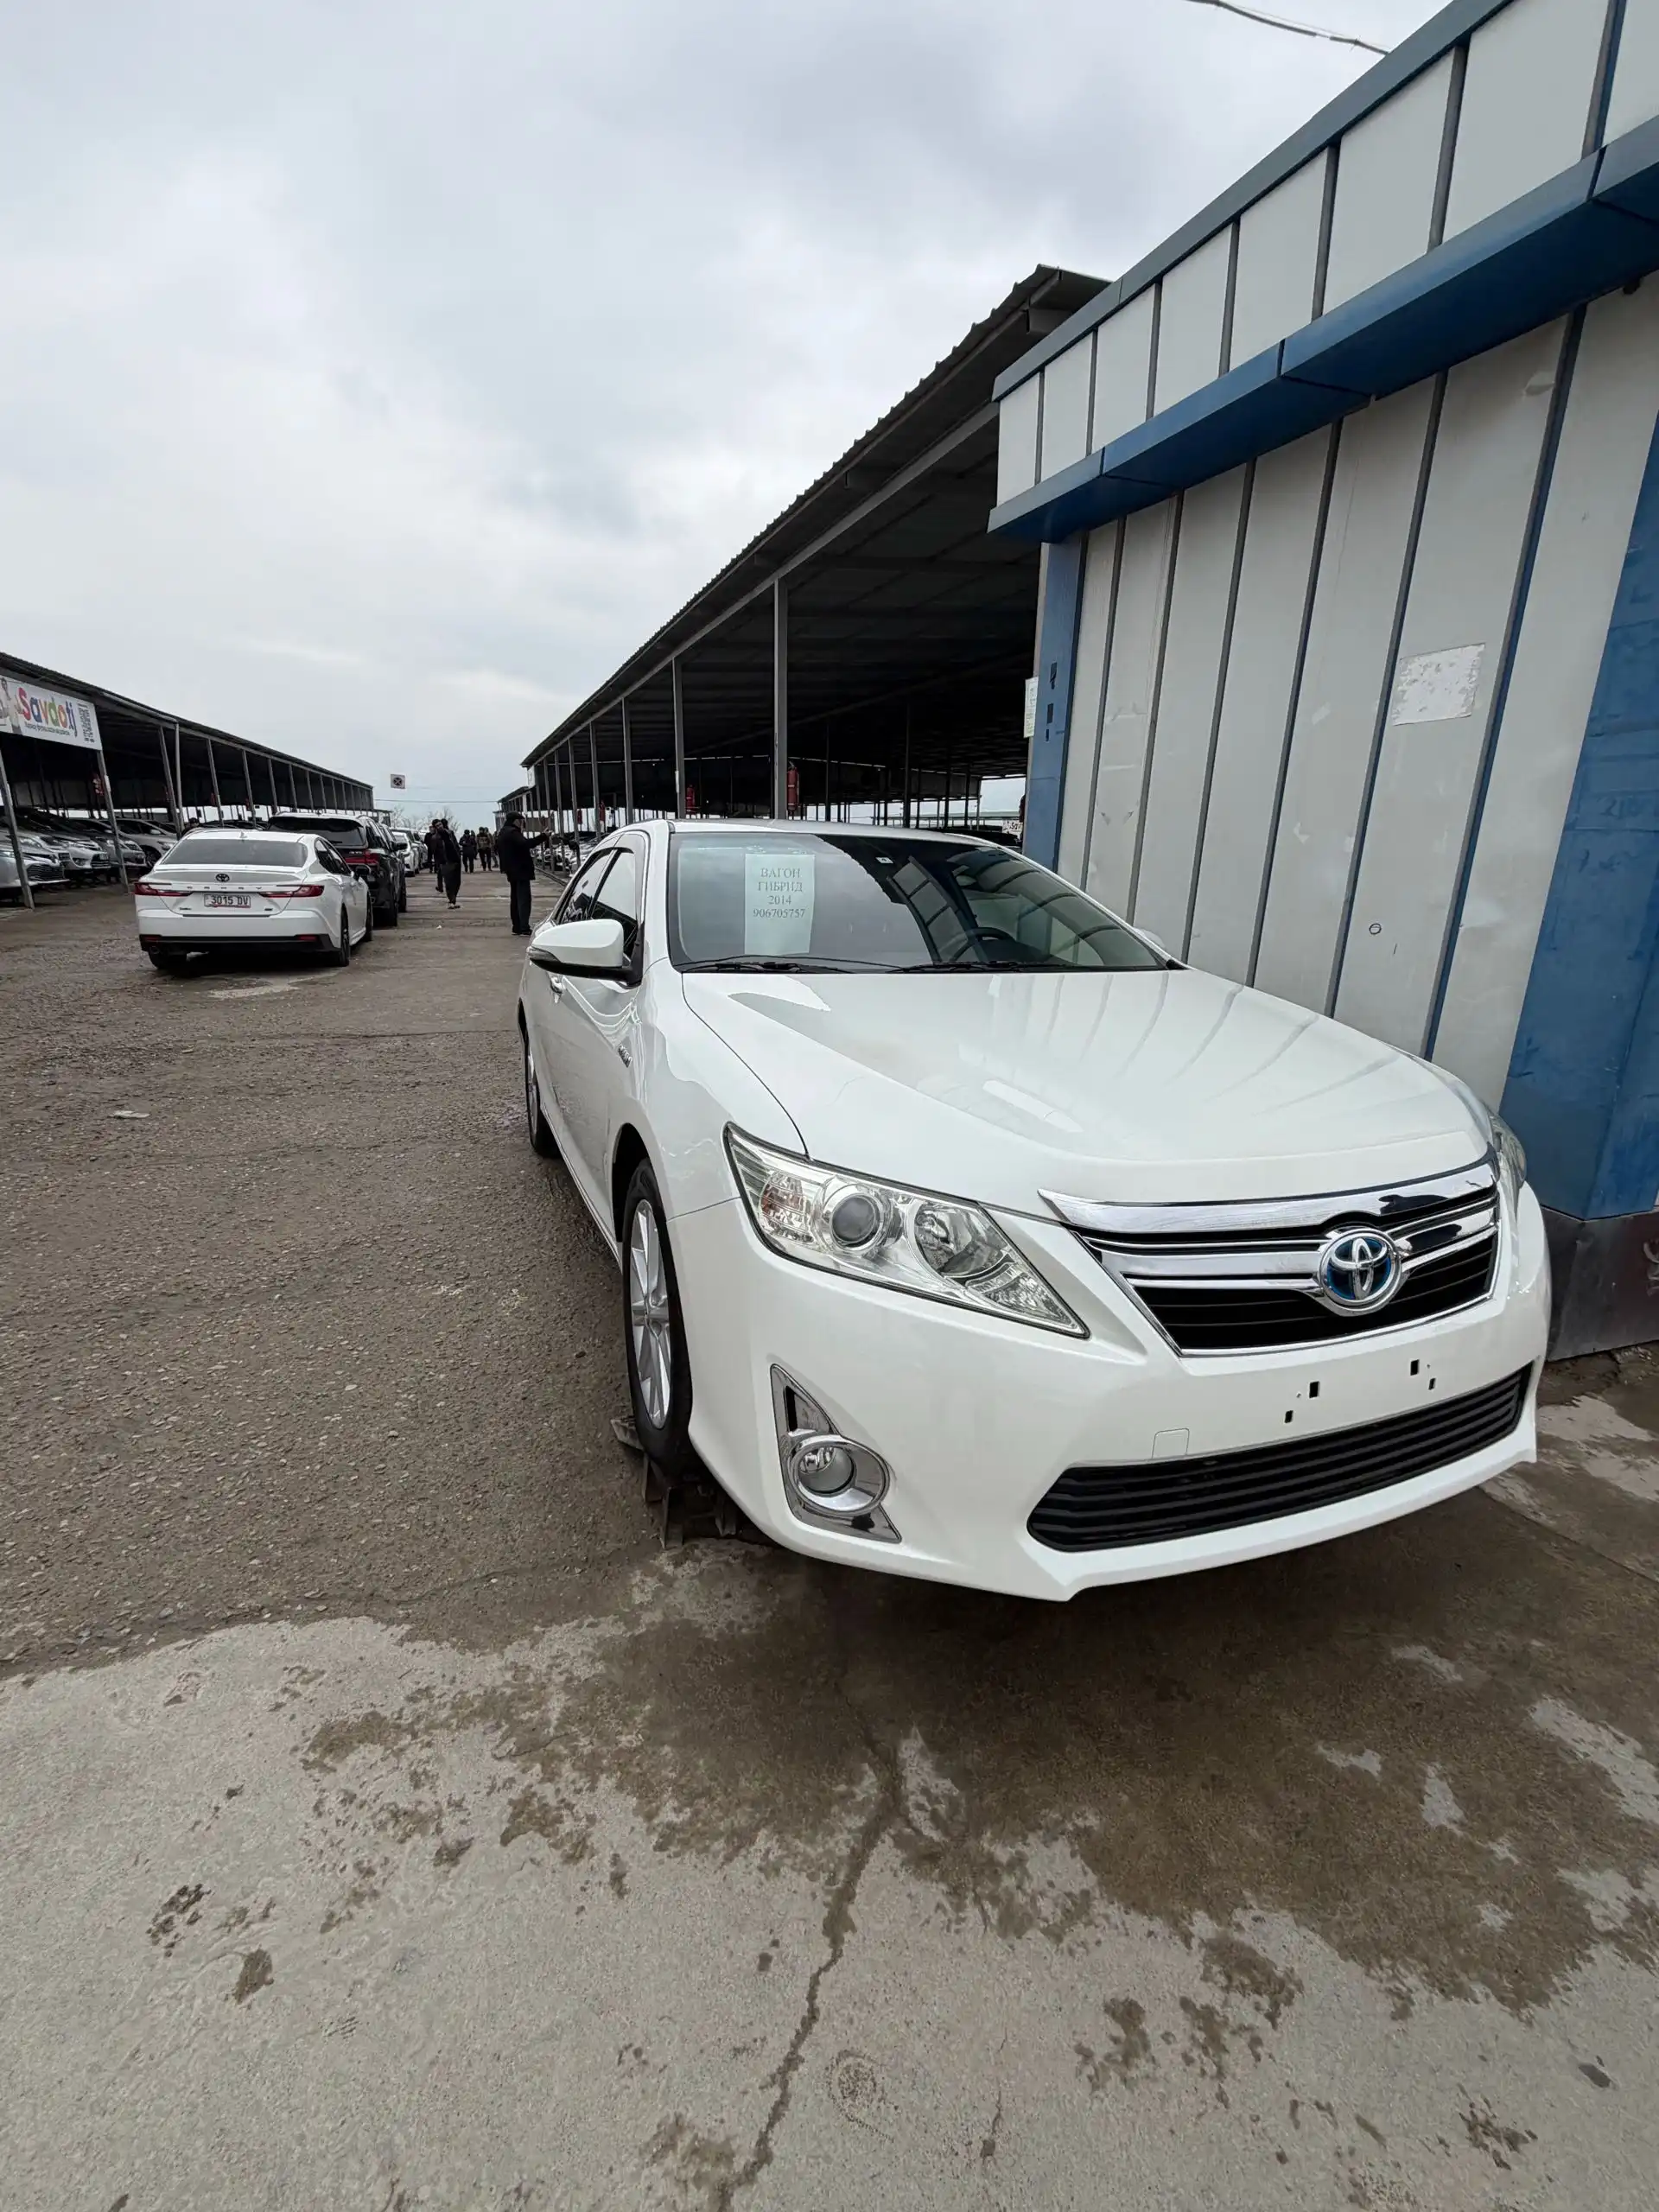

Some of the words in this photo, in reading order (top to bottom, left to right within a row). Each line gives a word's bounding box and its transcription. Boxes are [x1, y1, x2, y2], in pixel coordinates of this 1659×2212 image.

[760, 868, 801, 878] ВАГОН
[758, 881, 803, 892] ГИБРИД
[211, 894, 233, 905] 3015
[767, 895, 791, 905] 2014
[753, 909, 805, 918] 906705757
